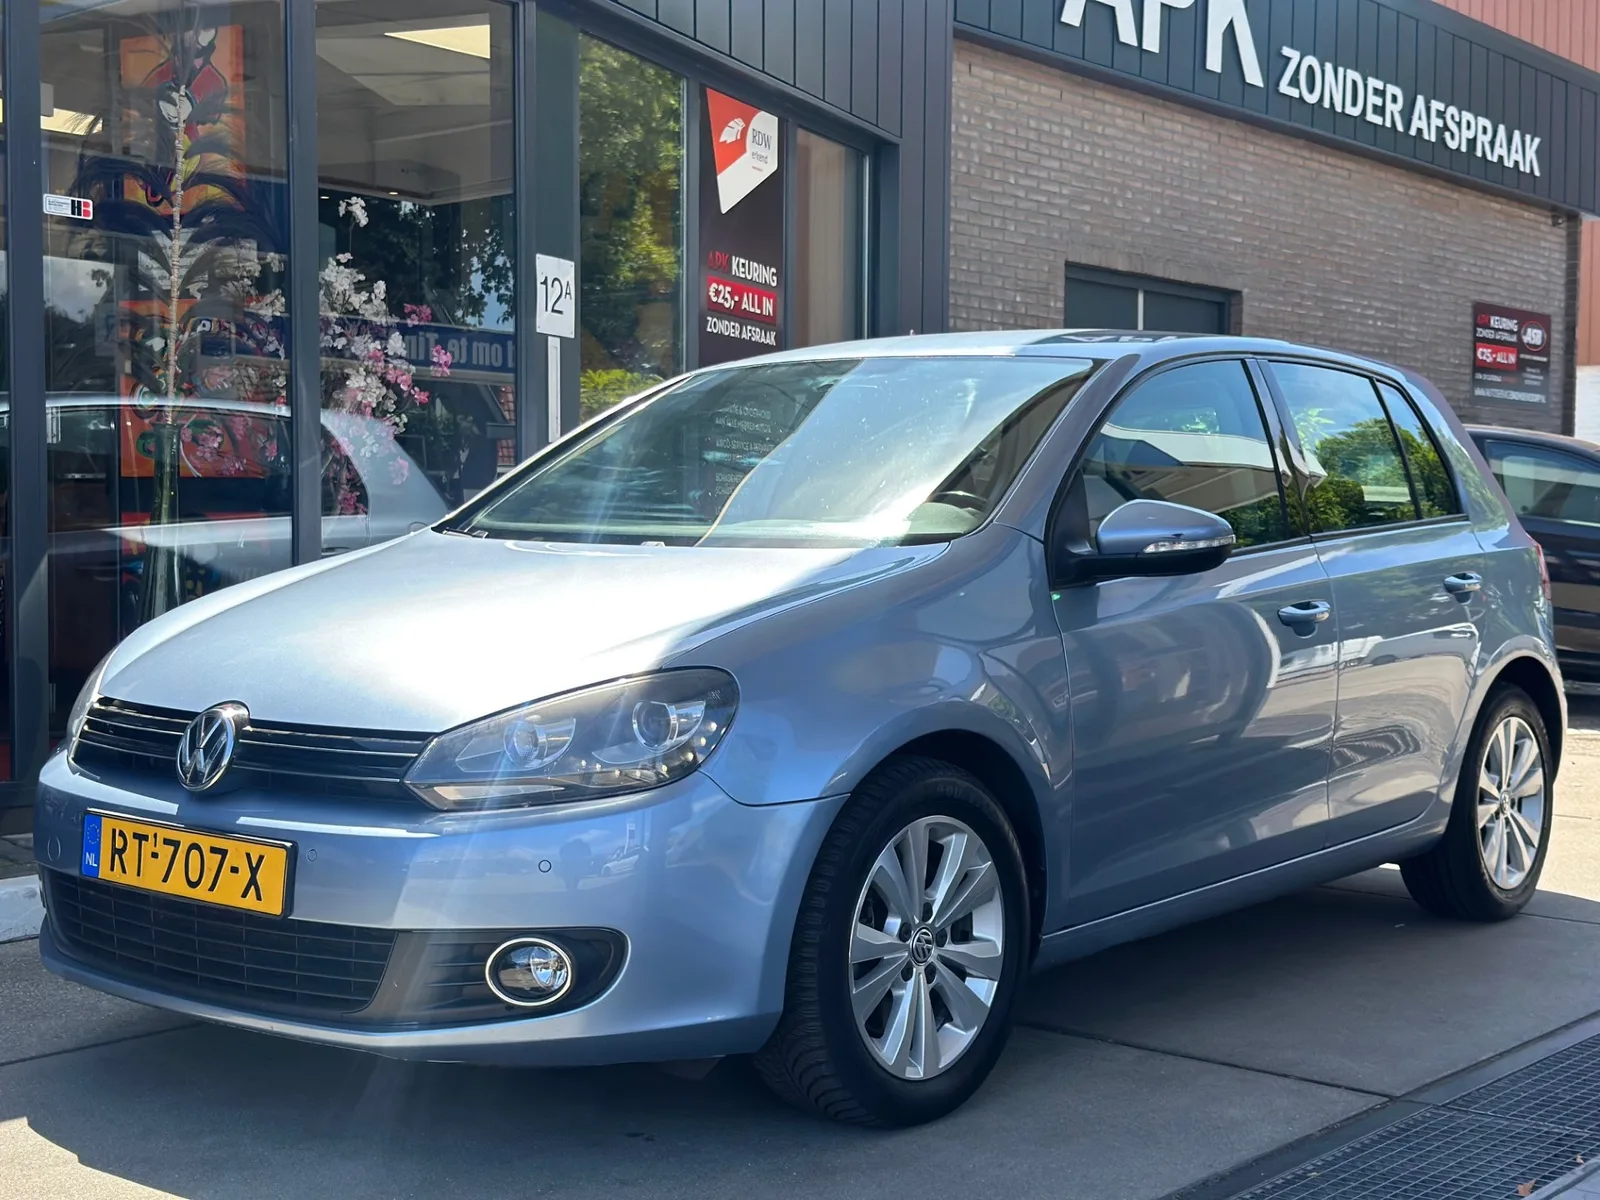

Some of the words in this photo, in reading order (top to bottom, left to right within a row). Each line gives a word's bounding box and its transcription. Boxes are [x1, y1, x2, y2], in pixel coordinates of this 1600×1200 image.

[1279, 45, 1404, 133] ZONDER
[1408, 94, 1542, 178] AFSPRAAK
[751, 127, 772, 150] RDW
[731, 255, 777, 287] KEURING
[708, 282, 739, 310] €25,-
[741, 292, 761, 314] ALL
[762, 296, 773, 317] IN
[706, 316, 740, 339] ZONDER
[85, 853, 98, 868] NL
[109, 828, 266, 902] RT-707-X
